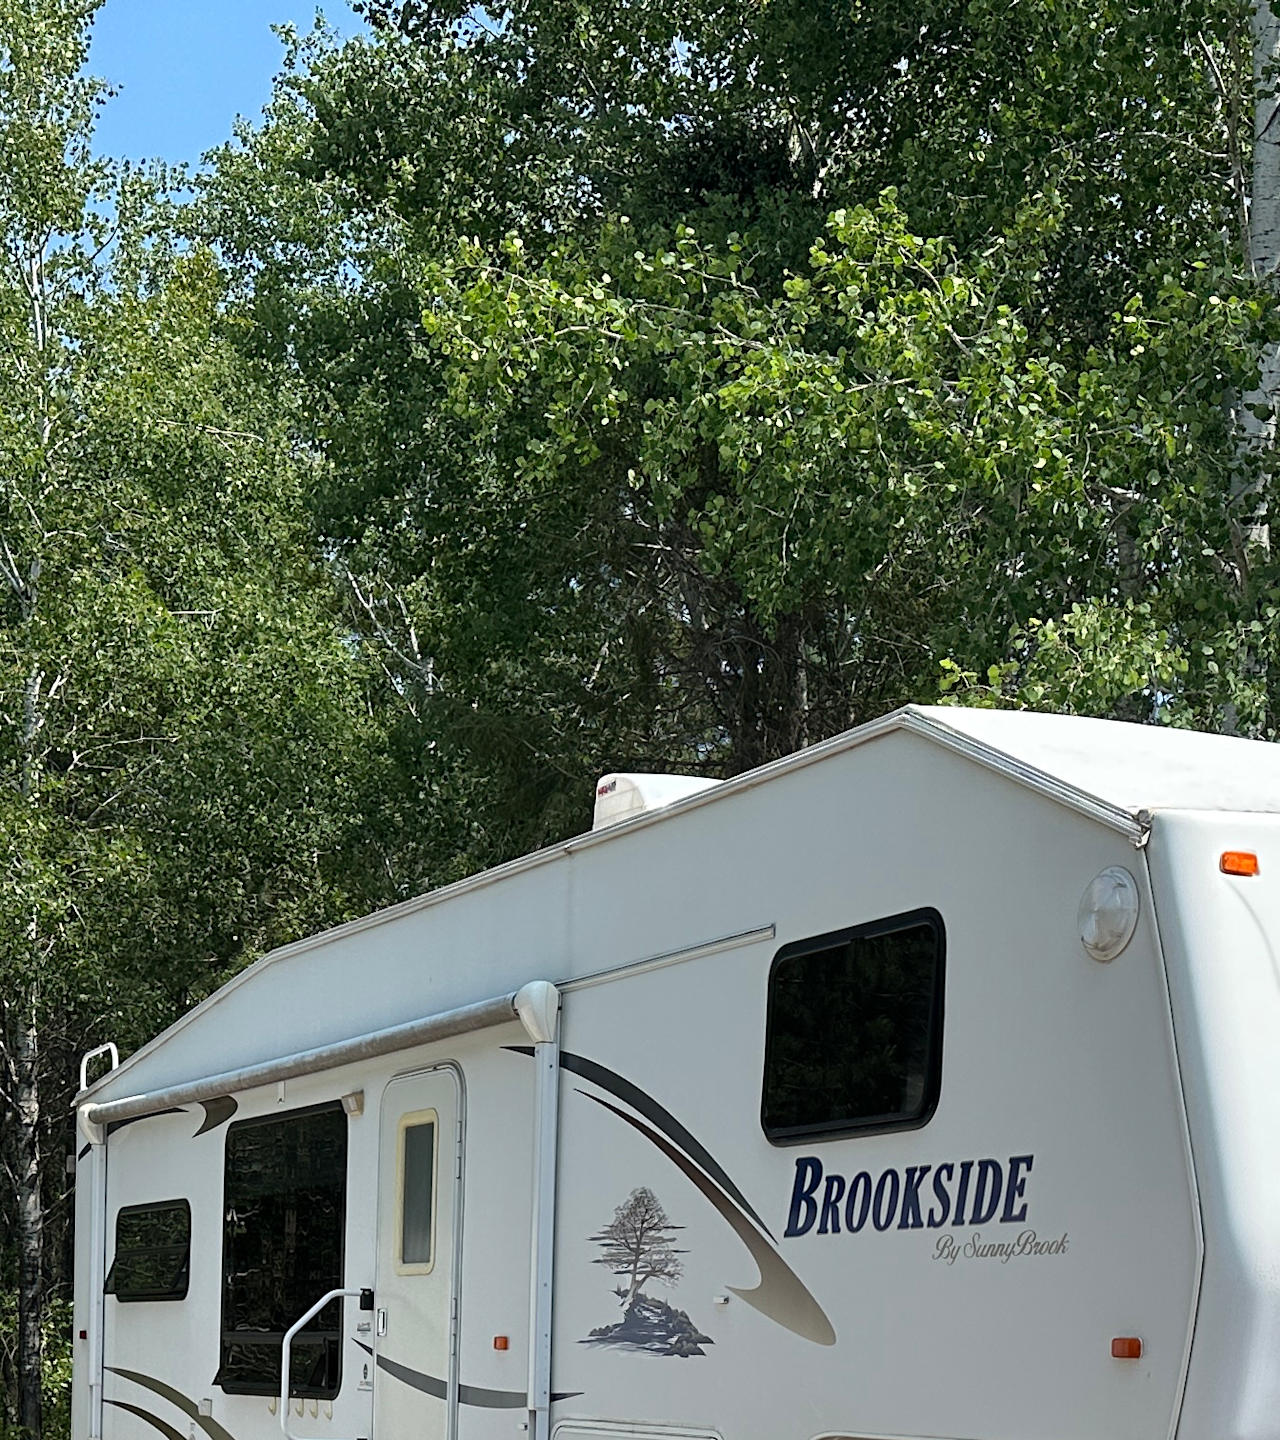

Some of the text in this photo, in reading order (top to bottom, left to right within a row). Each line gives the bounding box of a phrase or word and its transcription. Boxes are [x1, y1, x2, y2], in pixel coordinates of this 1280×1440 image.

[783, 1155, 1034, 1238] BROOKSIDE
[932, 1229, 1070, 1265] By SunnyBrook
